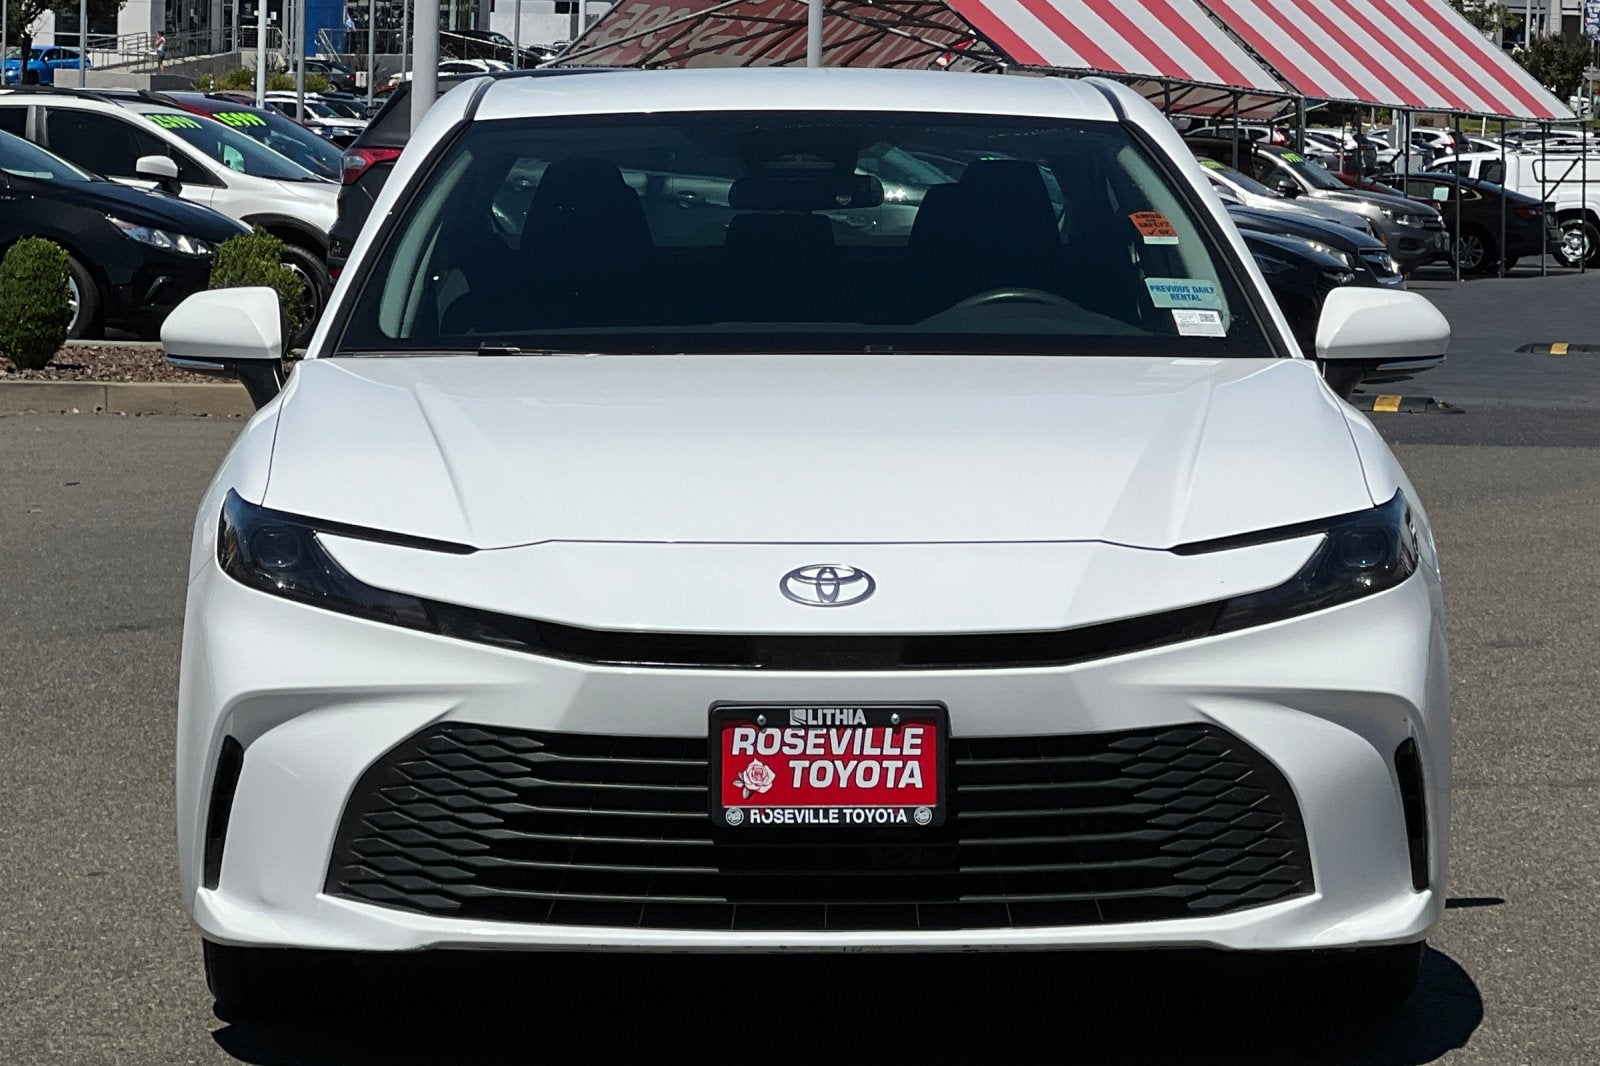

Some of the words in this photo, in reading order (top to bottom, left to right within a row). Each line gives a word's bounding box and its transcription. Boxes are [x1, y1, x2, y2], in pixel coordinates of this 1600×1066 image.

[1150, 285, 1190, 293] PREVIOUS
[1192, 286, 1215, 294] DAILY
[1170, 293, 1202, 301] RENTAL
[807, 708, 867, 726] LITHIA
[731, 727, 924, 756] ROSEVILLE
[789, 759, 923, 789] TOYOTA
[750, 809, 840, 824] ROSEVILLE
[843, 809, 908, 824] TOYOTA
